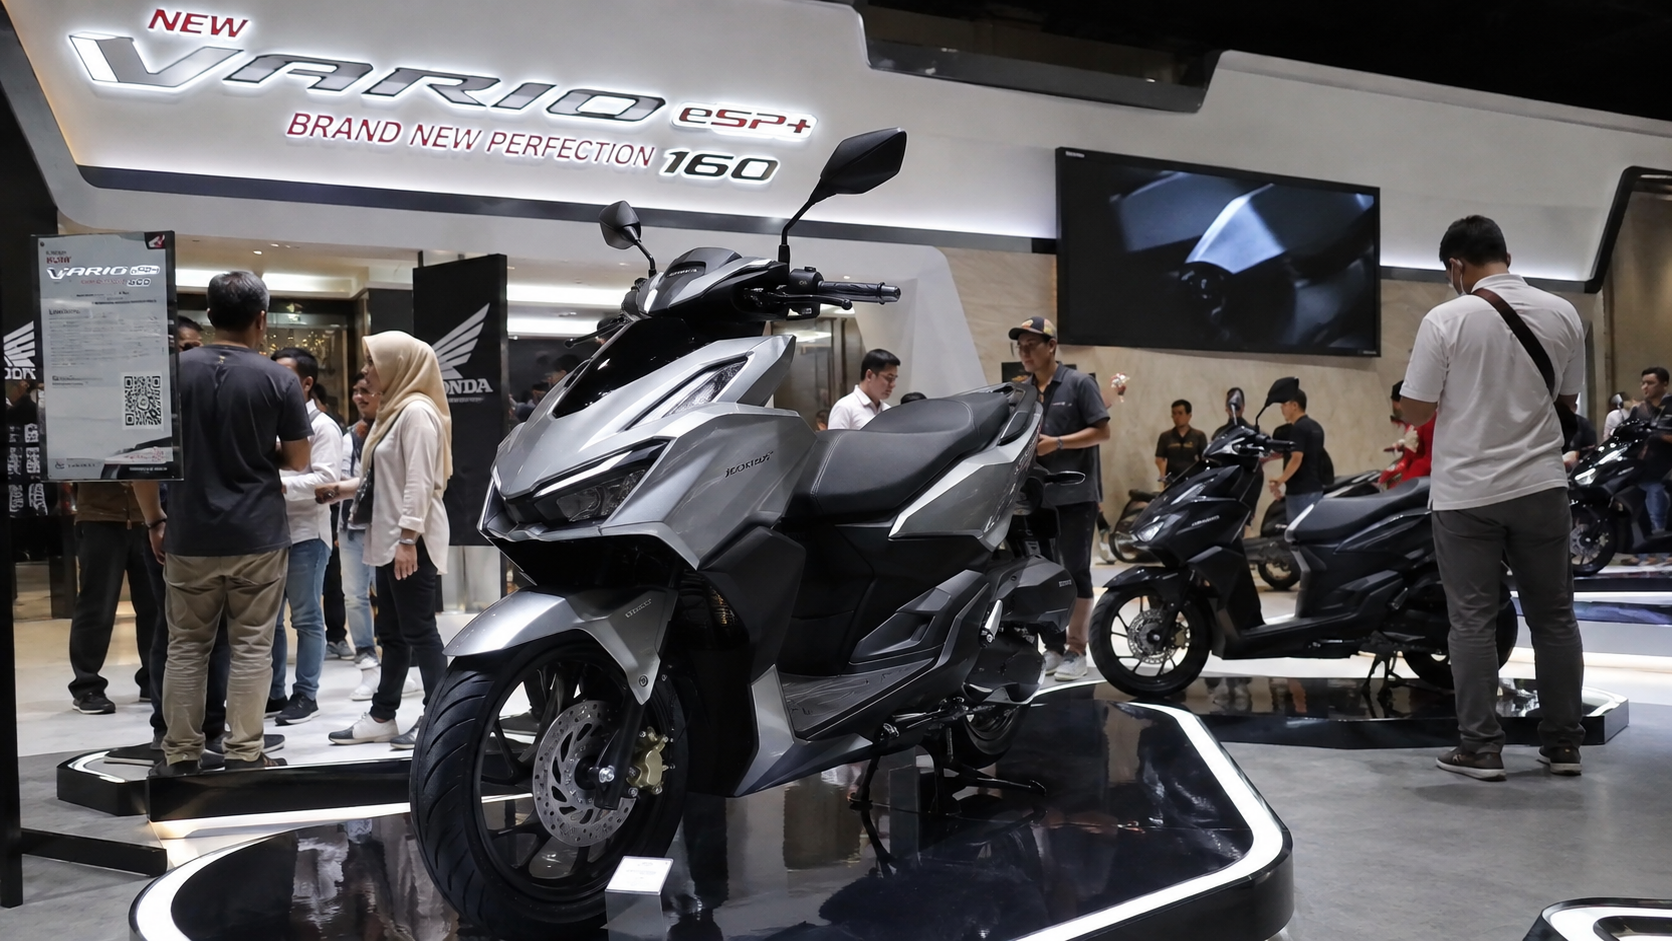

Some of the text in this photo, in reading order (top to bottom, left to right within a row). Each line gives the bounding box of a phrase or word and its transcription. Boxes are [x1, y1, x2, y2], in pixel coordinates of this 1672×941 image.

[148, 8, 250, 38] NEW
[68, 33, 811, 134] VARIO eSP+
[286, 112, 779, 181] BRAND NEW PERFECTION 160
[46, 265, 129, 280] VARIO
